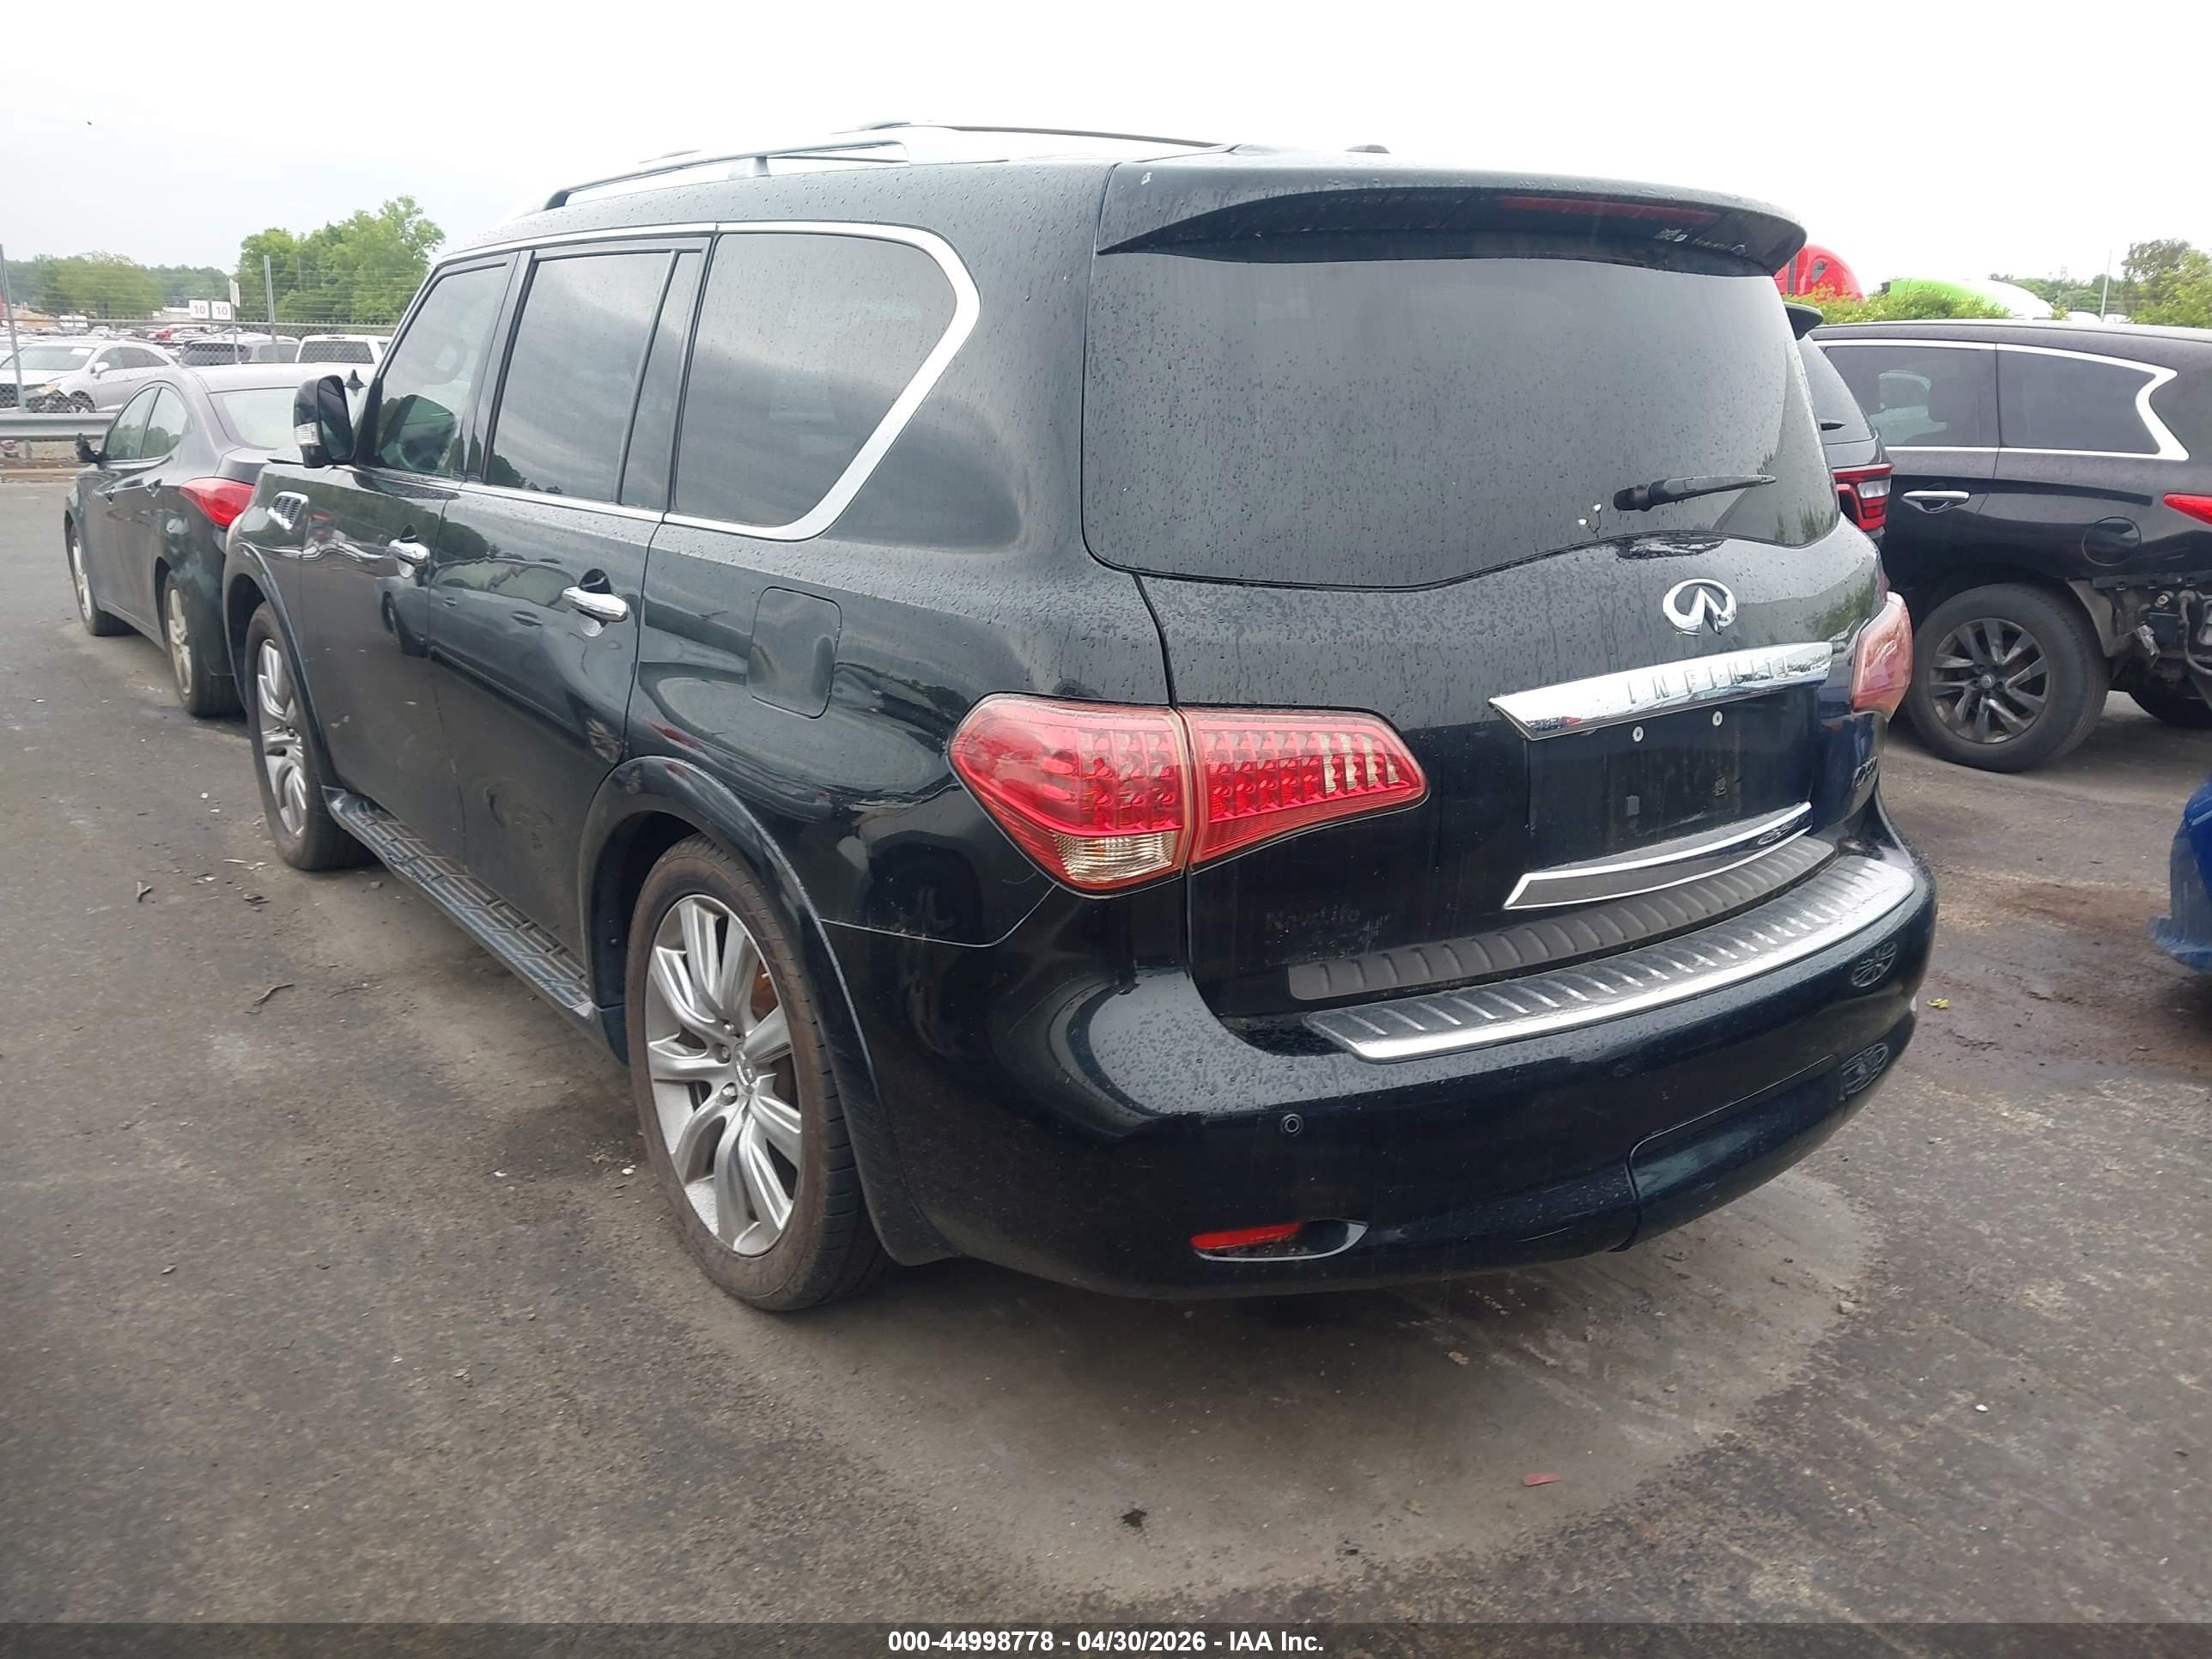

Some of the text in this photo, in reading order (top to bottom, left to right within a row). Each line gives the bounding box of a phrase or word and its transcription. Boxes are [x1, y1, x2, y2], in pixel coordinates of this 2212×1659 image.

[193, 305, 206, 315] 10
[216, 306, 228, 316] 10
[1626, 657, 1790, 704] INFINITI
